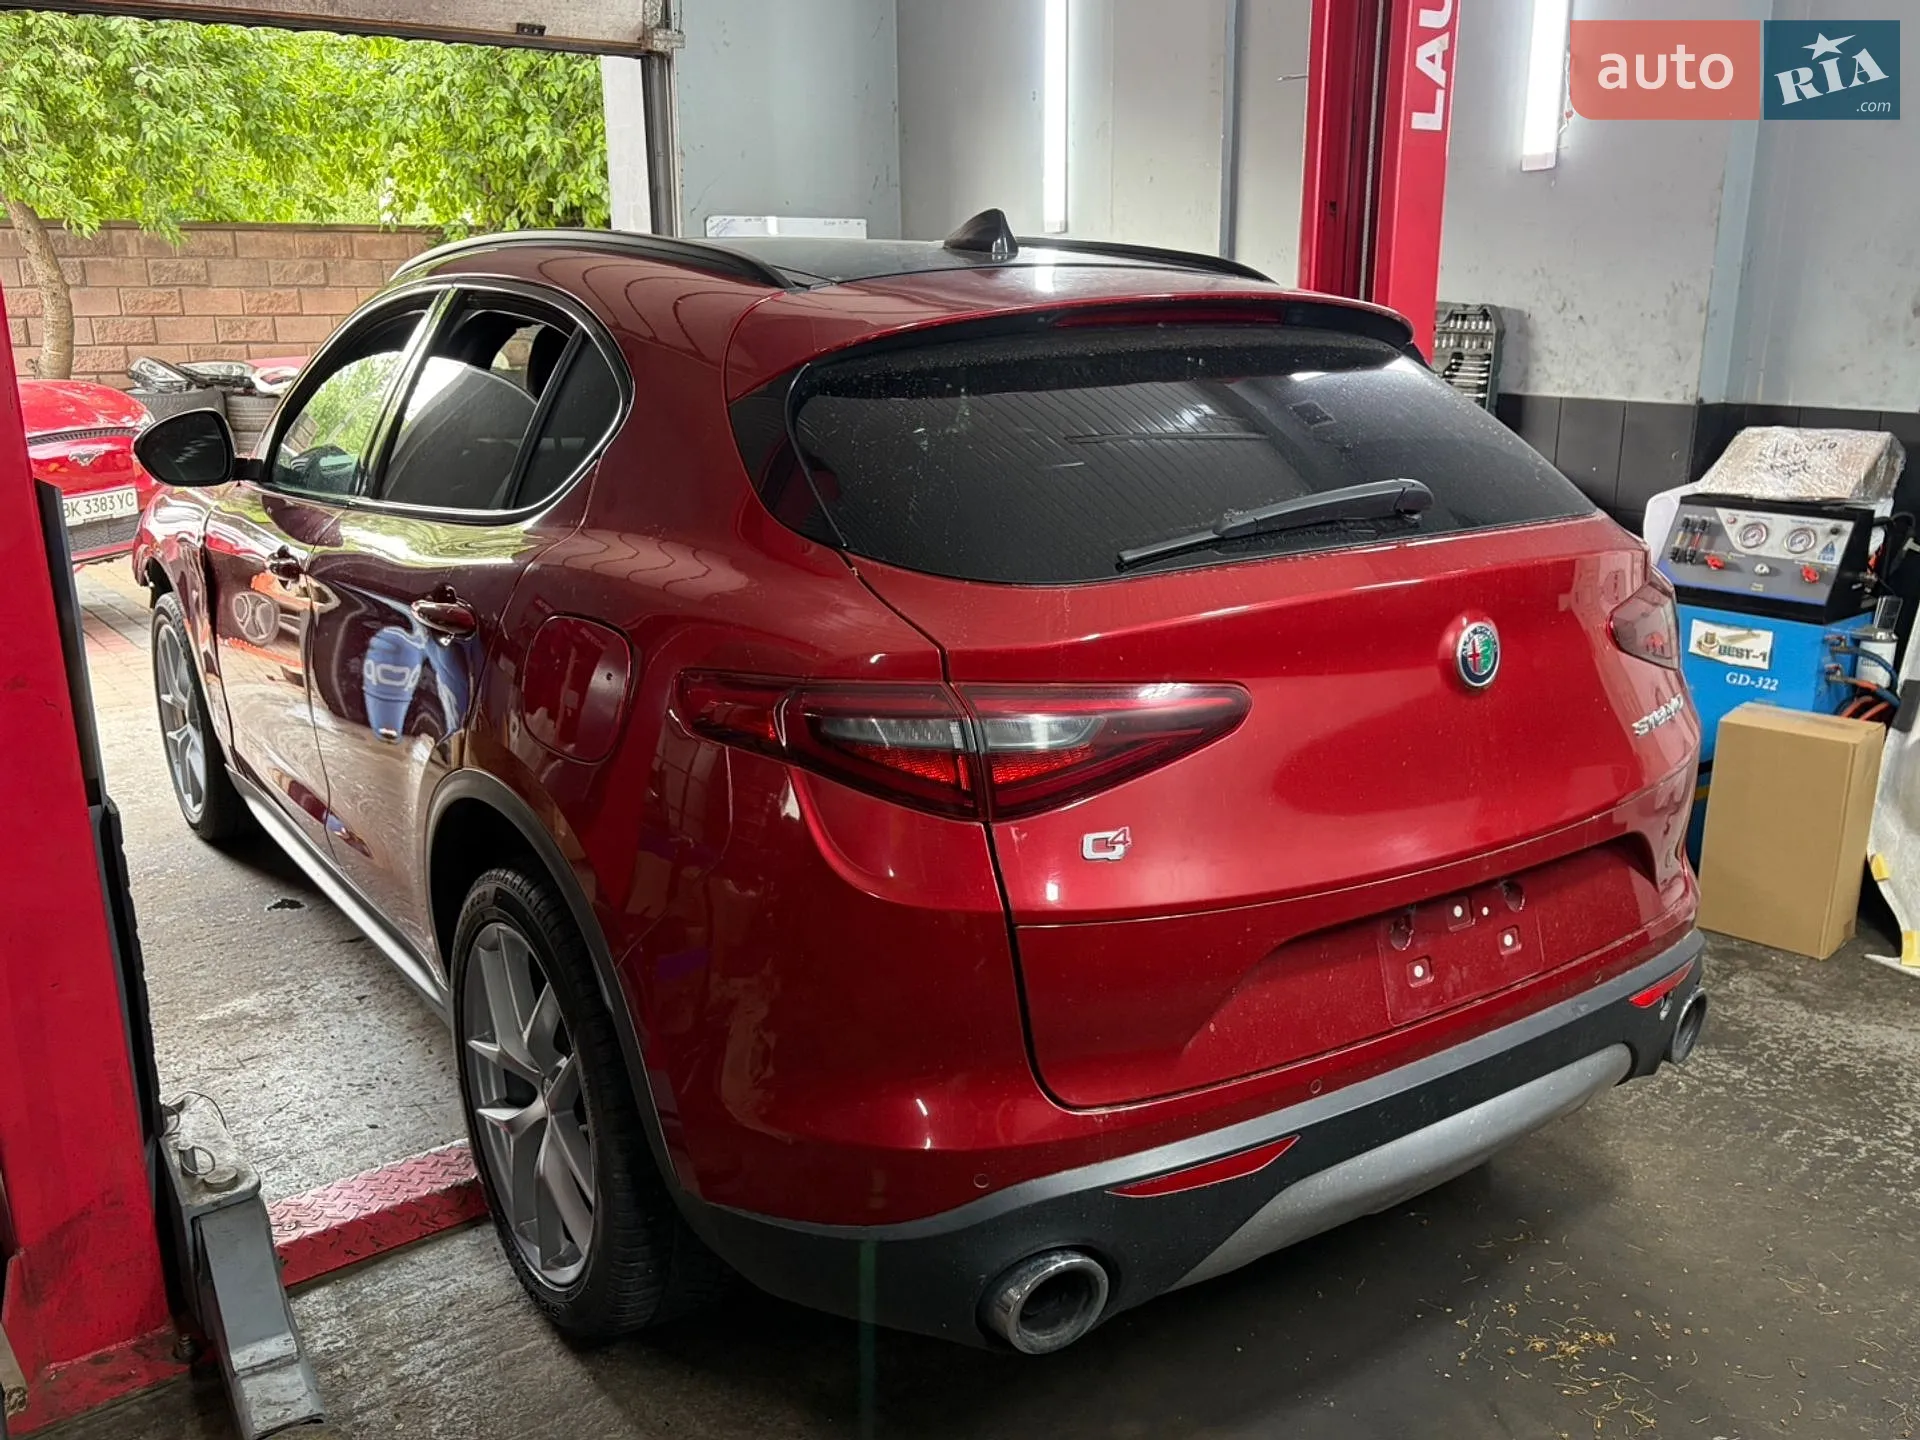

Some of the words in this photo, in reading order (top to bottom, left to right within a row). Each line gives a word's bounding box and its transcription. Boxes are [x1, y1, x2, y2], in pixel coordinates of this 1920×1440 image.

[84, 496, 116, 515] 3383
[117, 492, 134, 509] YC
[1719, 645, 1768, 662] BEST-1
[1725, 671, 1779, 691] GD-322
[1082, 826, 1132, 861] Q4
